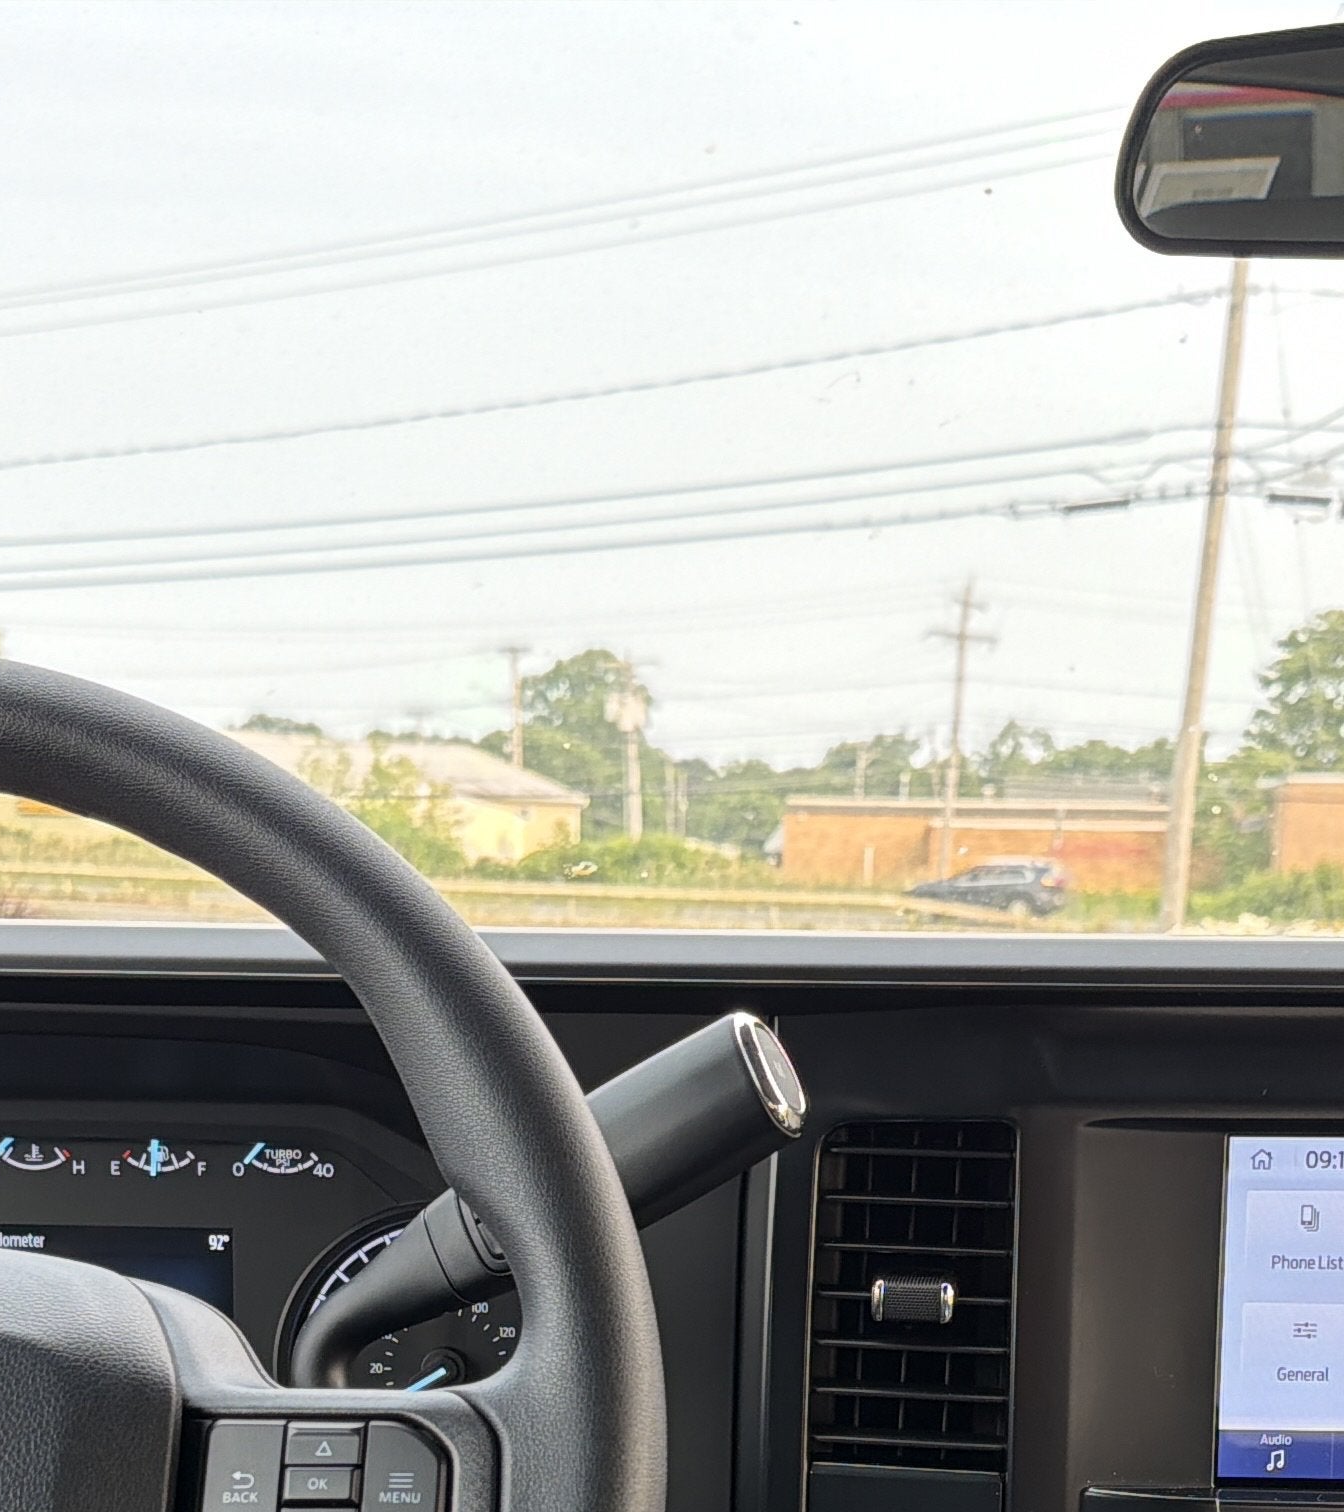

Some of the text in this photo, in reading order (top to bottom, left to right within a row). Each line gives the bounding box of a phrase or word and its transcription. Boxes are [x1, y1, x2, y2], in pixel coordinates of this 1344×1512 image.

[264, 1149, 302, 1160] TURBO
[72, 1161, 85, 1175] H
[111, 1161, 121, 1175] E
[197, 1163, 207, 1177] F
[313, 1163, 335, 1178] 40
[1271, 1255, 1344, 1271] Phone List
[499, 1327, 516, 1338] 120
[369, 1363, 383, 1374] 20
[1276, 1367, 1330, 1383] General
[1260, 1434, 1292, 1447] Audio
[307, 1477, 329, 1490] OK
[222, 1491, 258, 1504] BACK
[379, 1492, 422, 1504] MENU
